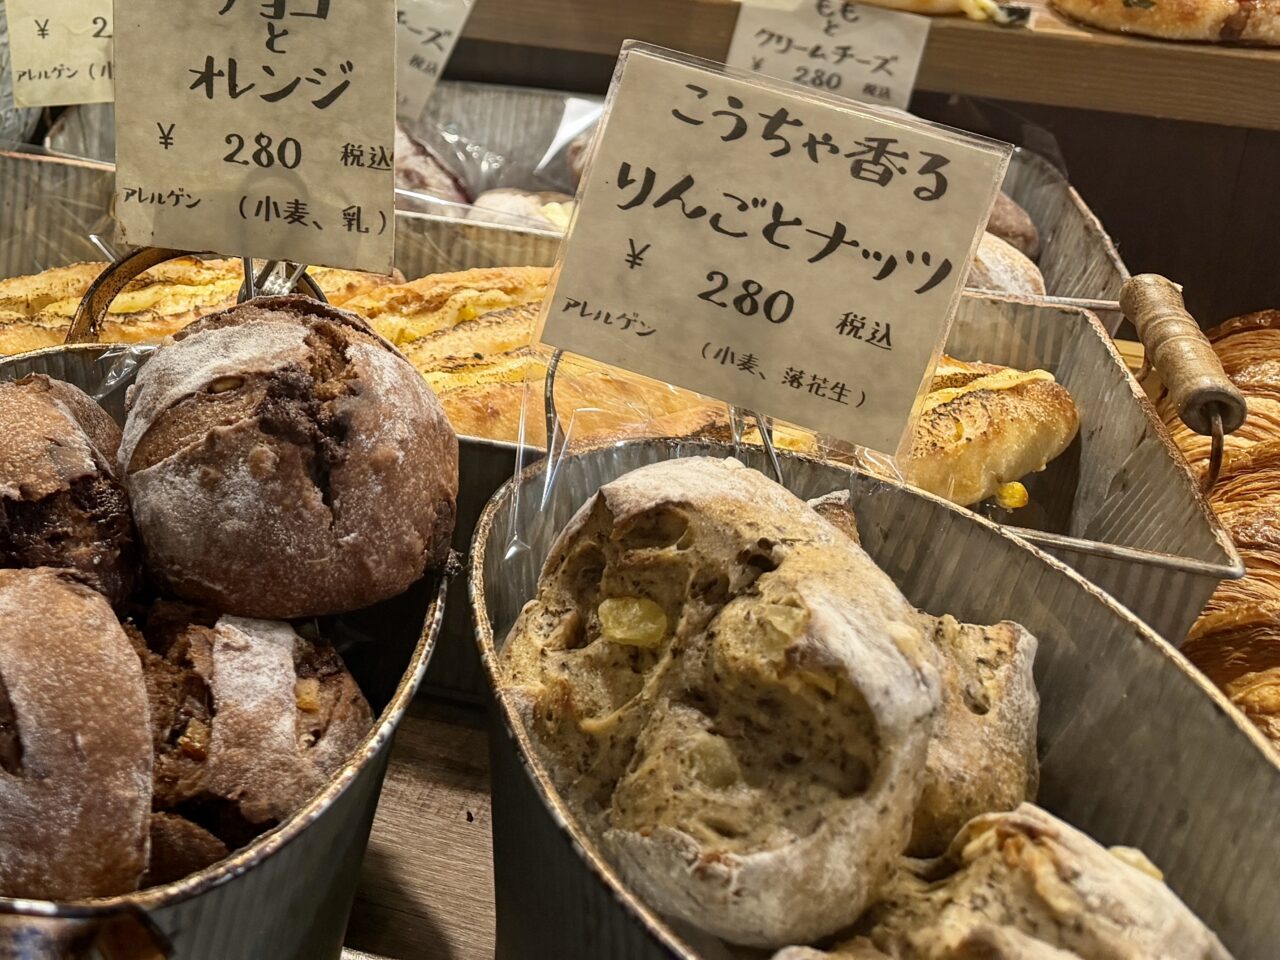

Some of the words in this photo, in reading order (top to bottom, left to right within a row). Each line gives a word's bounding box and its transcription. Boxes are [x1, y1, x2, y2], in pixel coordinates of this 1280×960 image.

[33, 17, 50, 39] ¥
[265, 22, 288, 54] と
[823, 19, 840, 37] と
[16, 63, 78, 82] アレルゲン
[754, 27, 899, 77] クリームチーズ
[188, 55, 354, 110] オレンジ
[751, 56, 764, 72] ¥
[793, 65, 842, 90] 280
[862, 82, 891, 100] 税込
[156, 122, 176, 150] ¥
[222, 132, 302, 169] 280
[340, 142, 393, 171] 税込
[671, 83, 952, 202] こうちゃ香る
[123, 186, 202, 208] アレルゲン
[616, 161, 954, 294] りんごとナッツ
[625, 238, 651, 269] ¥
[697, 270, 795, 324] 280
[835, 311, 894, 351] 税込
[561, 296, 657, 338] アレルゲン
